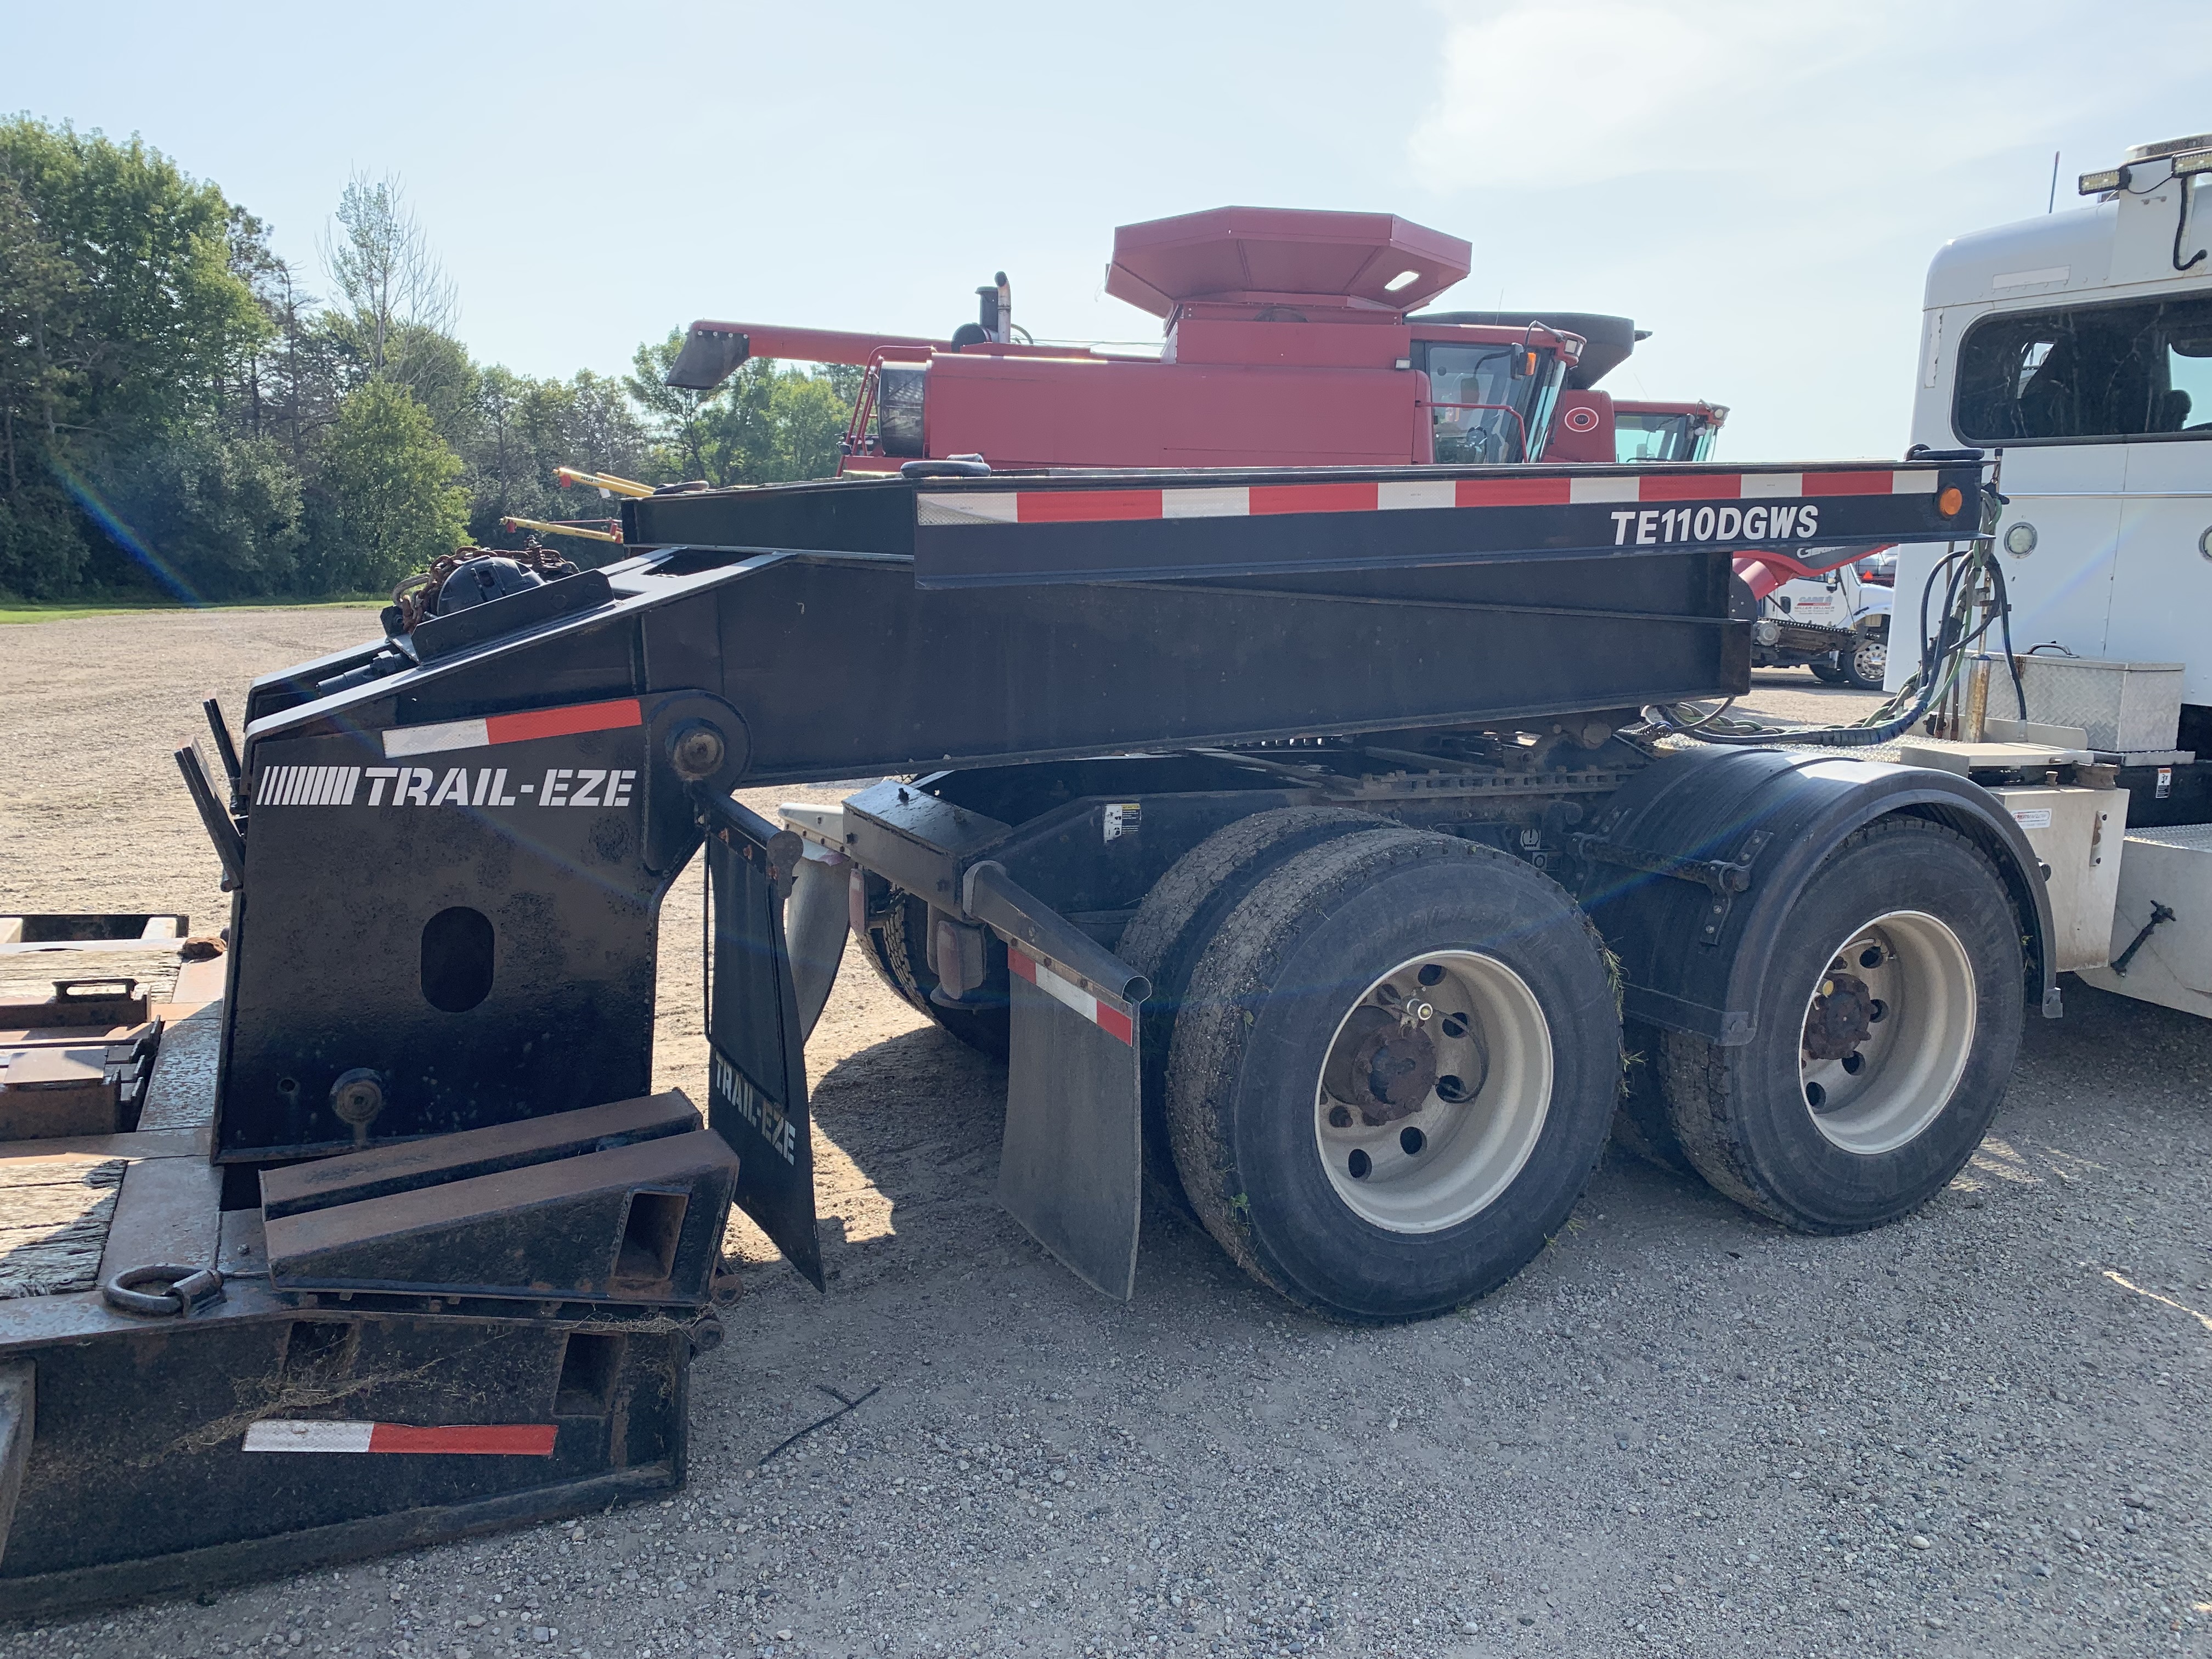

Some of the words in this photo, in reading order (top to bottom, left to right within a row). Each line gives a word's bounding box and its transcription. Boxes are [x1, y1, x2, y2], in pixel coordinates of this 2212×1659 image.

[1611, 505, 1819, 545] TE110DGWS
[365, 767, 636, 806] TRAIL-EZE
[715, 1051, 796, 1166] TRAIL-EZE
